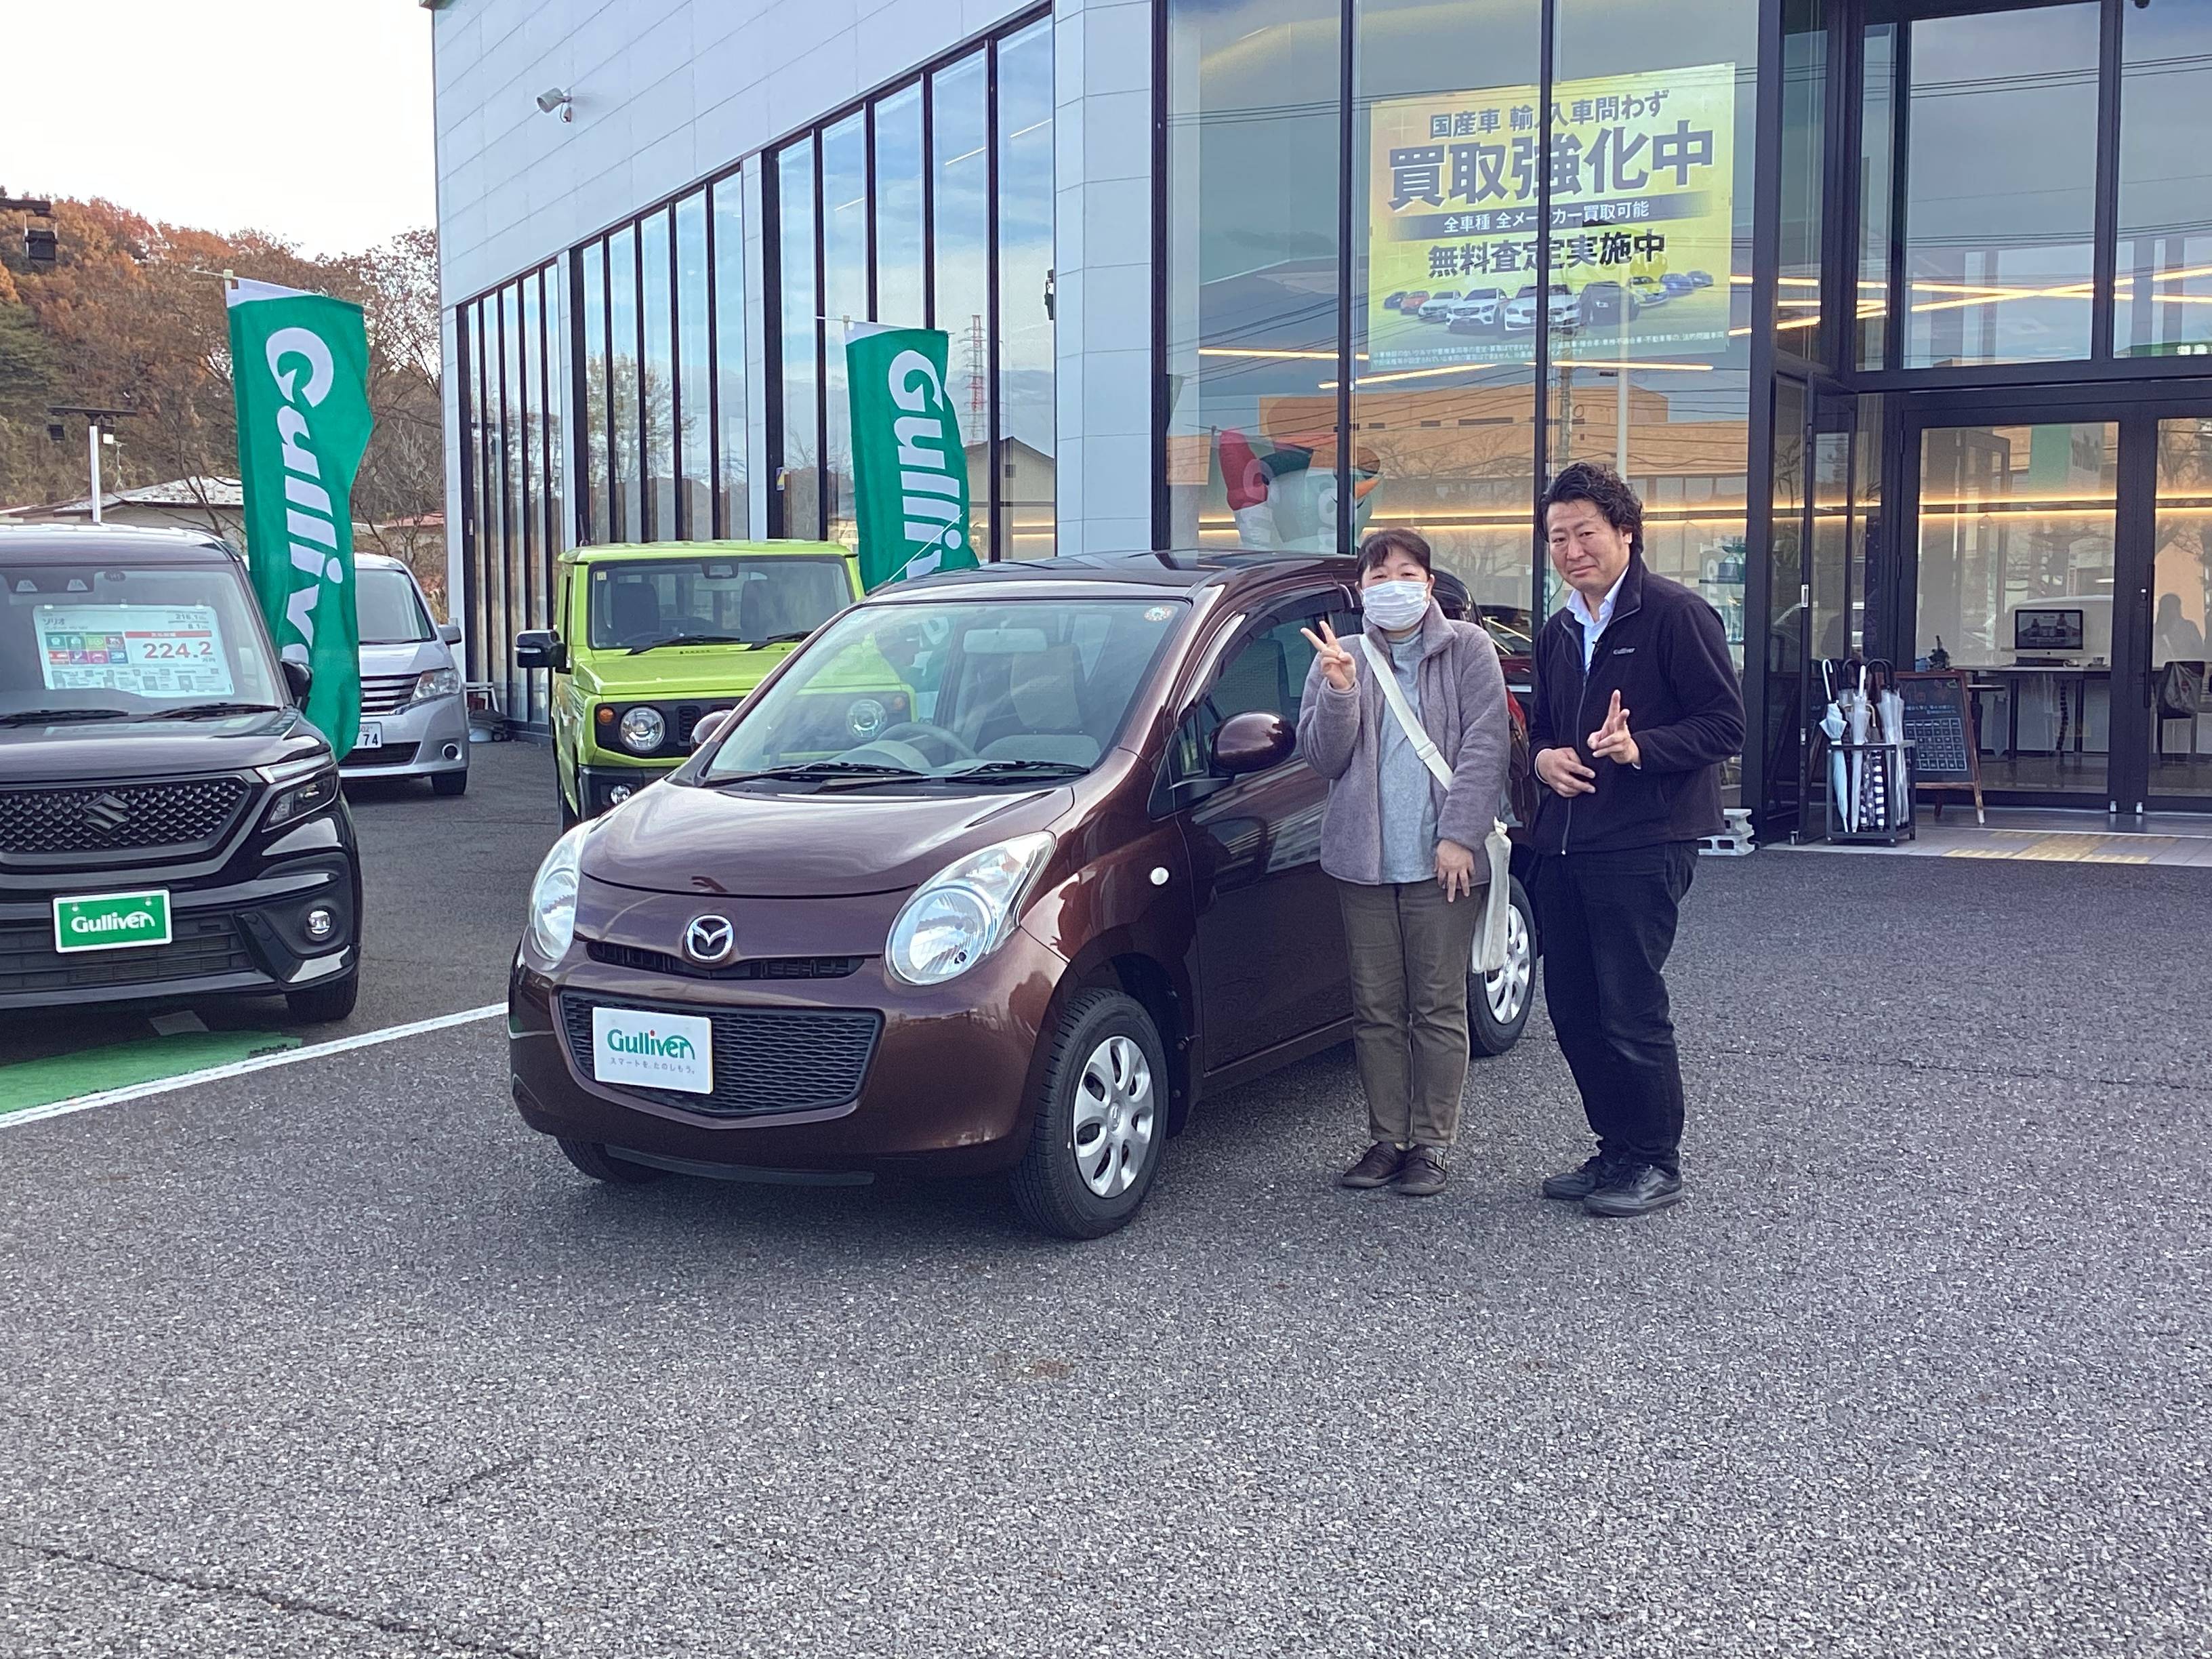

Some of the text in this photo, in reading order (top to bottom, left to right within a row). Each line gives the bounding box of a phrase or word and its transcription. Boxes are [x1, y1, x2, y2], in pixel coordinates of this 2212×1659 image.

[1431, 89, 1669, 138] 国産車 輸入車問わず
[1388, 119, 1714, 212] 買取強化中
[1443, 201, 1650, 234] 全車種 全メーカー買取可能
[1428, 228, 1666, 279] 無料査定実施中
[142, 640, 213, 659] 224.2
[70, 911, 156, 933] Gulliver
[607, 1029, 696, 1060] Gulliver
